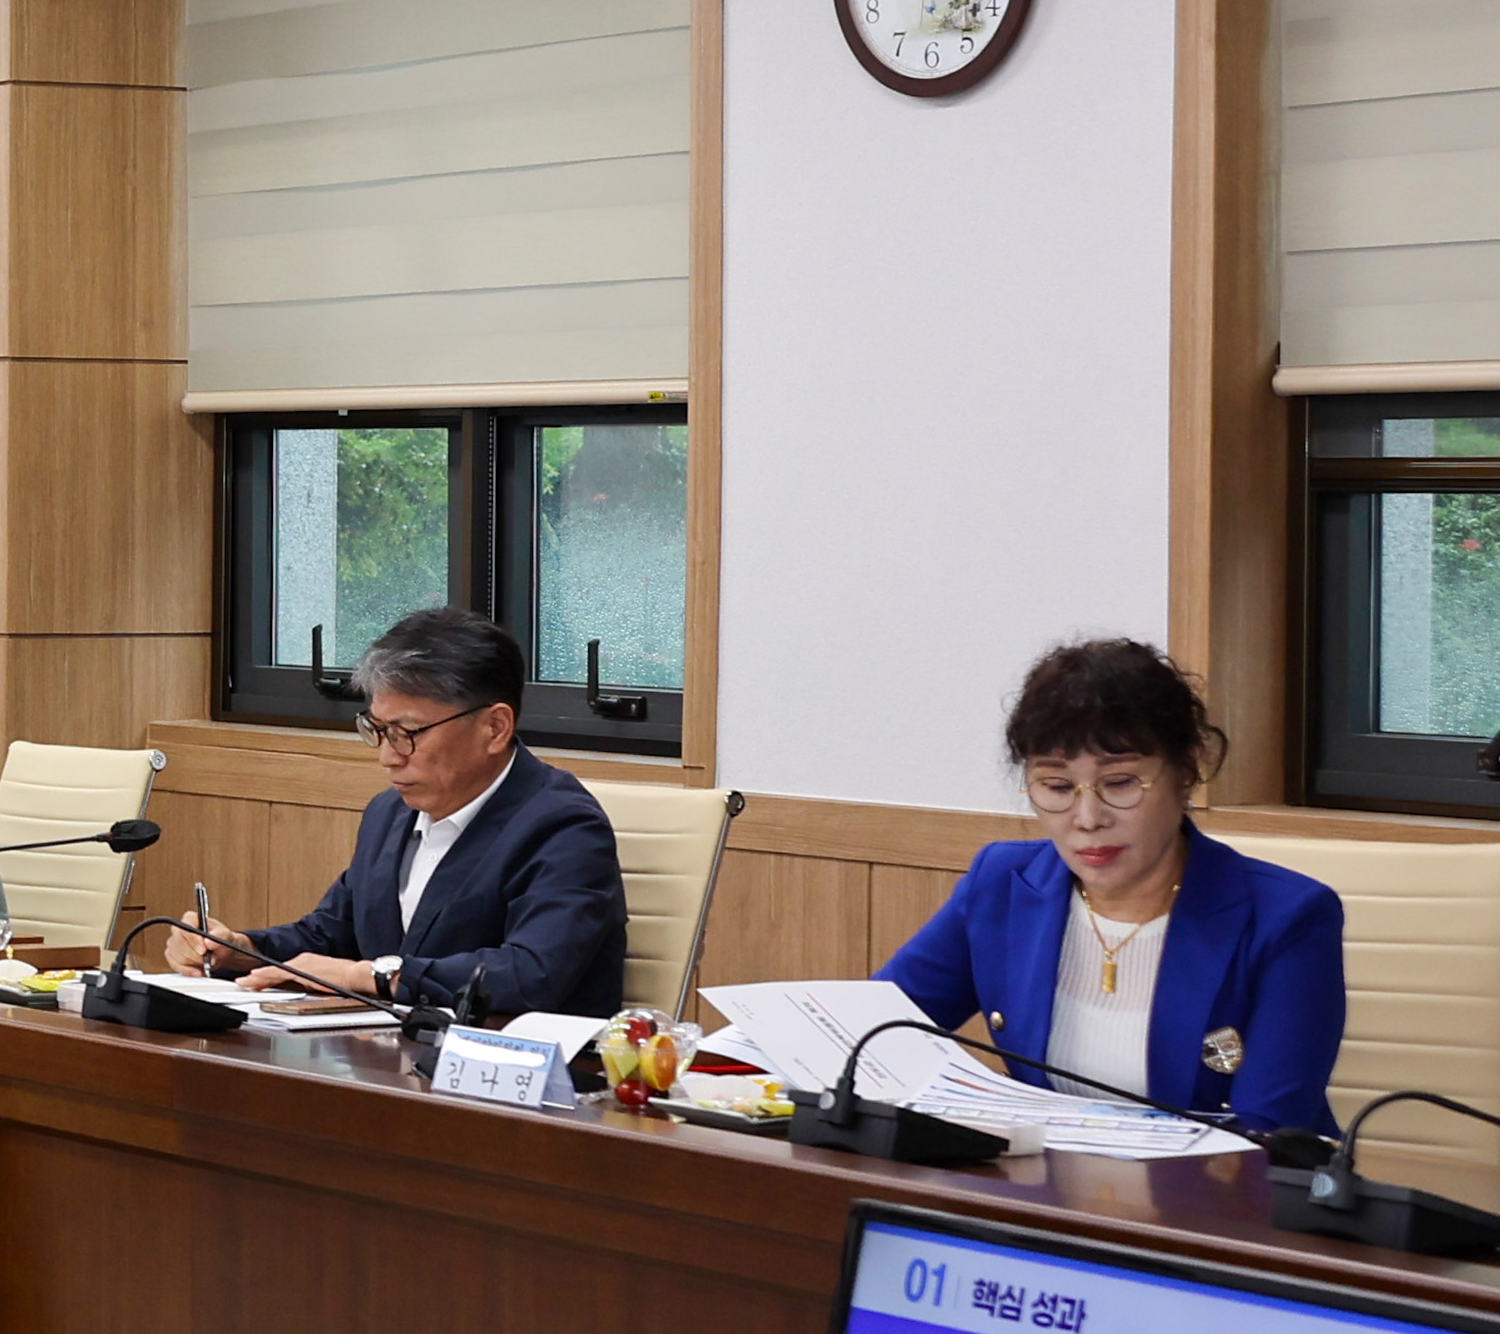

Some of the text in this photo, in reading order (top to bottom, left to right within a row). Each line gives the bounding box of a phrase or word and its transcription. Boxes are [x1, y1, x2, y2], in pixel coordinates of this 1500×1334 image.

[892, 31, 906, 57] 7
[960, 28, 974, 54] 5
[925, 42, 939, 68] 6
[901, 1256, 947, 1309] 01
[971, 1279, 1088, 1334] 핵심 성과
